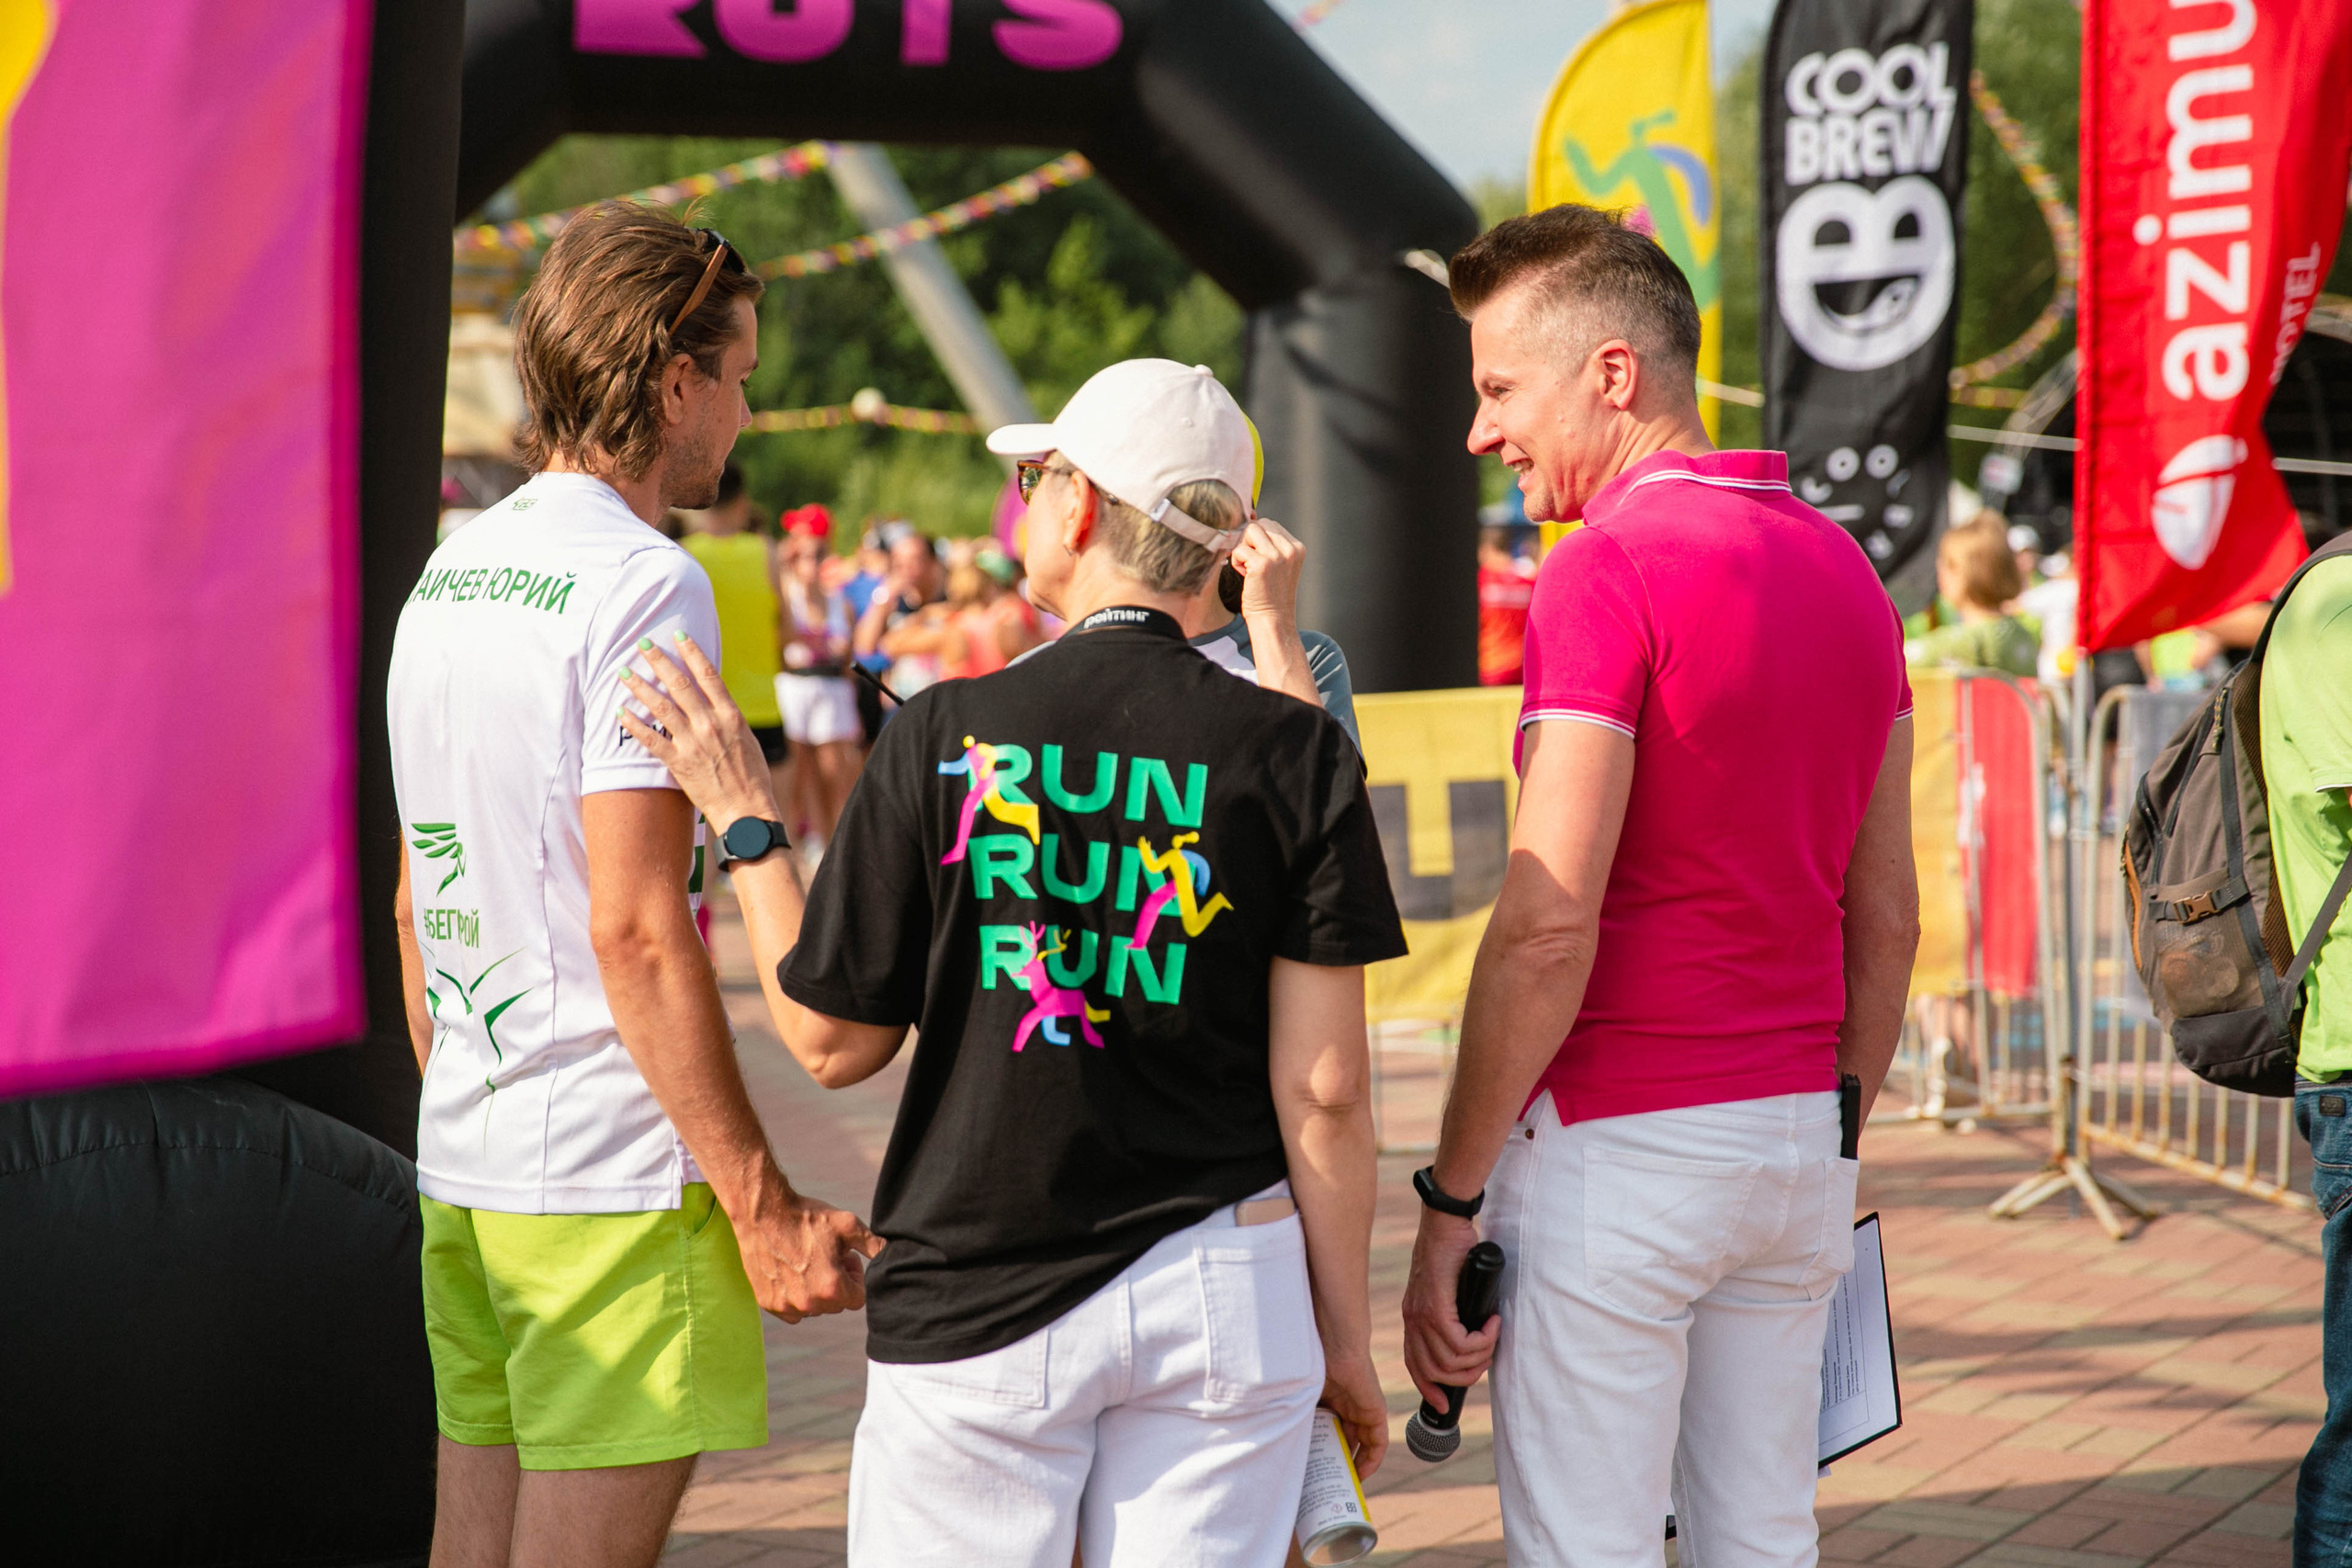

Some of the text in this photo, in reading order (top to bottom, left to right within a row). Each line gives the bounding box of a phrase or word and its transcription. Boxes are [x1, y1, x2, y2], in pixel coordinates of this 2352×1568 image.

[1784, 41, 1957, 117] COOL
[1784, 107, 1955, 186] BREW
[2134, 0, 2257, 401] azimu
[405, 567, 577, 615] АИЧЕВ ЮРИЙ
[967, 743, 1208, 828] RUN
[967, 832, 1197, 918] RUN
[978, 924, 1187, 1005] RUN
